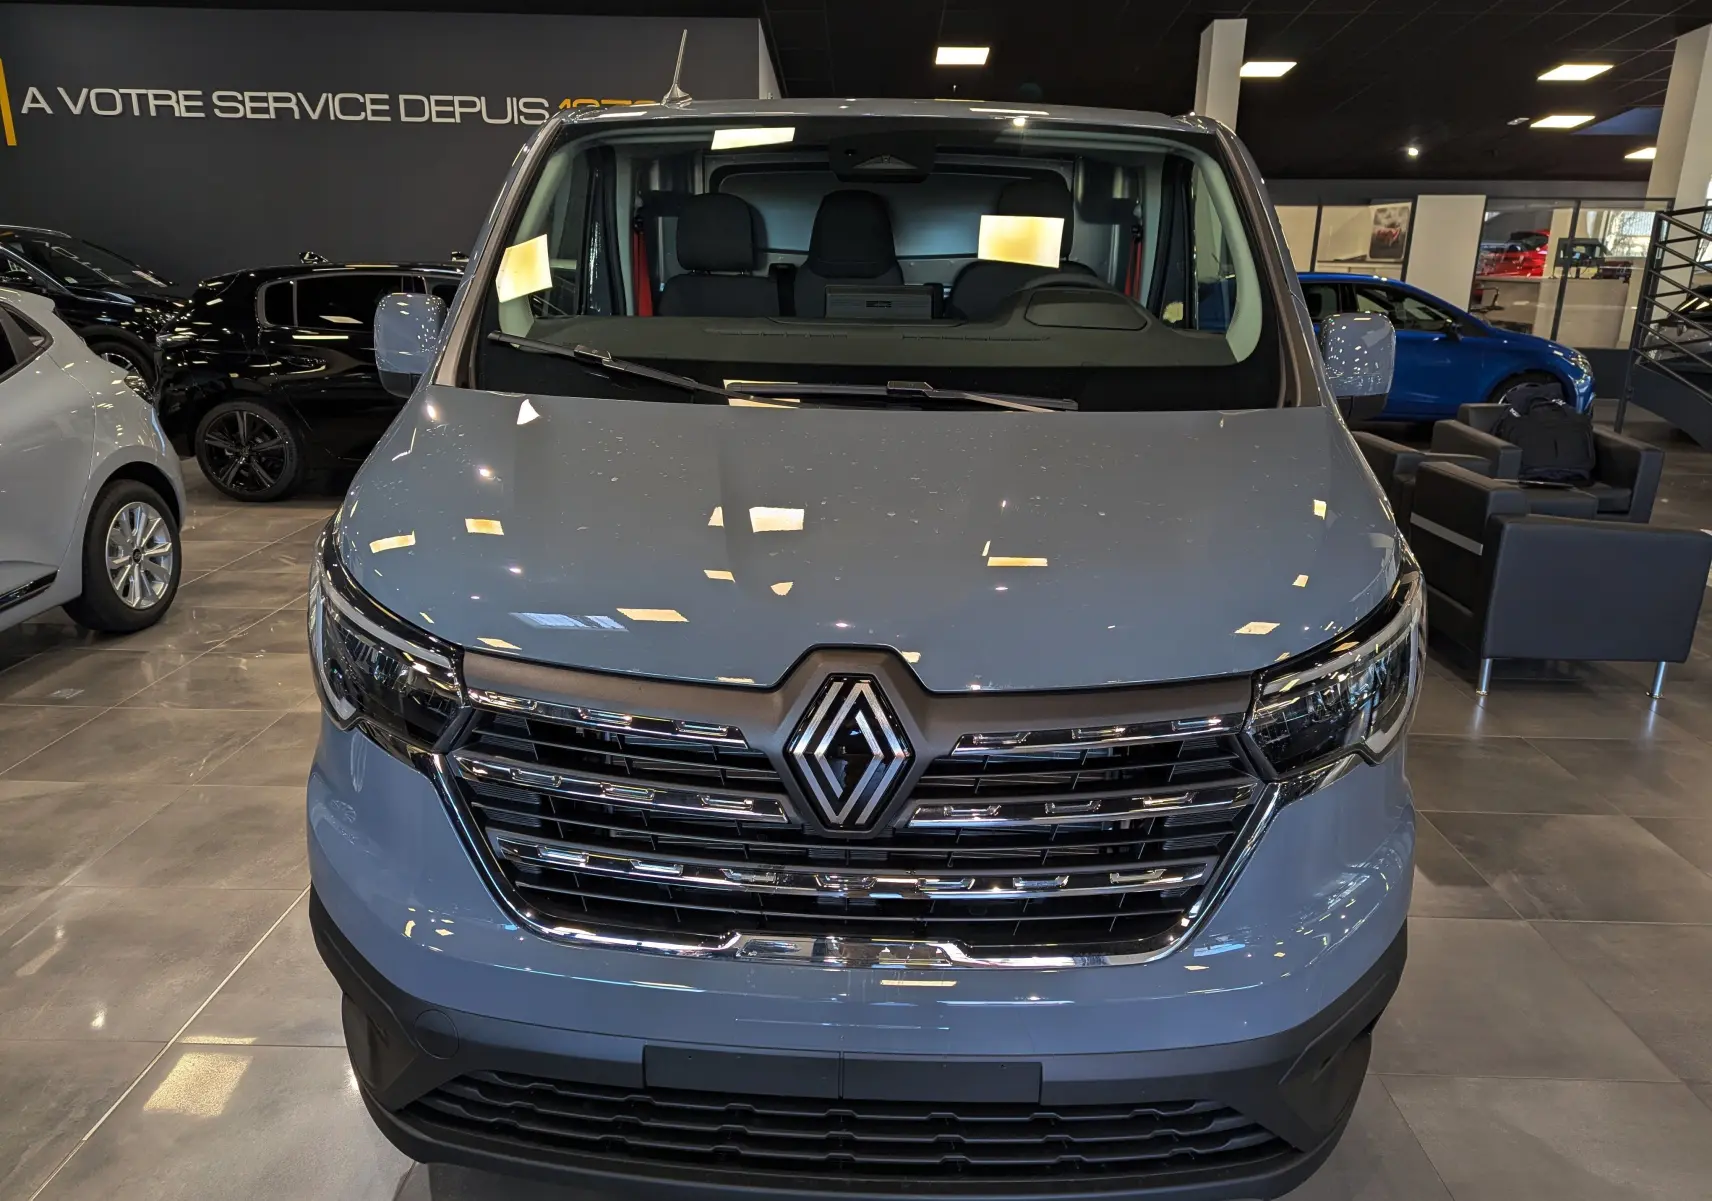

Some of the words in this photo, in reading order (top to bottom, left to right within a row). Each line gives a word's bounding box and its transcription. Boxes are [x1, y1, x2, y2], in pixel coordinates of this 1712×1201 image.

[21, 86, 53, 114] A
[57, 87, 206, 117] VOTRE
[212, 90, 392, 121] SERVICE
[398, 94, 550, 125] DEPUIS
